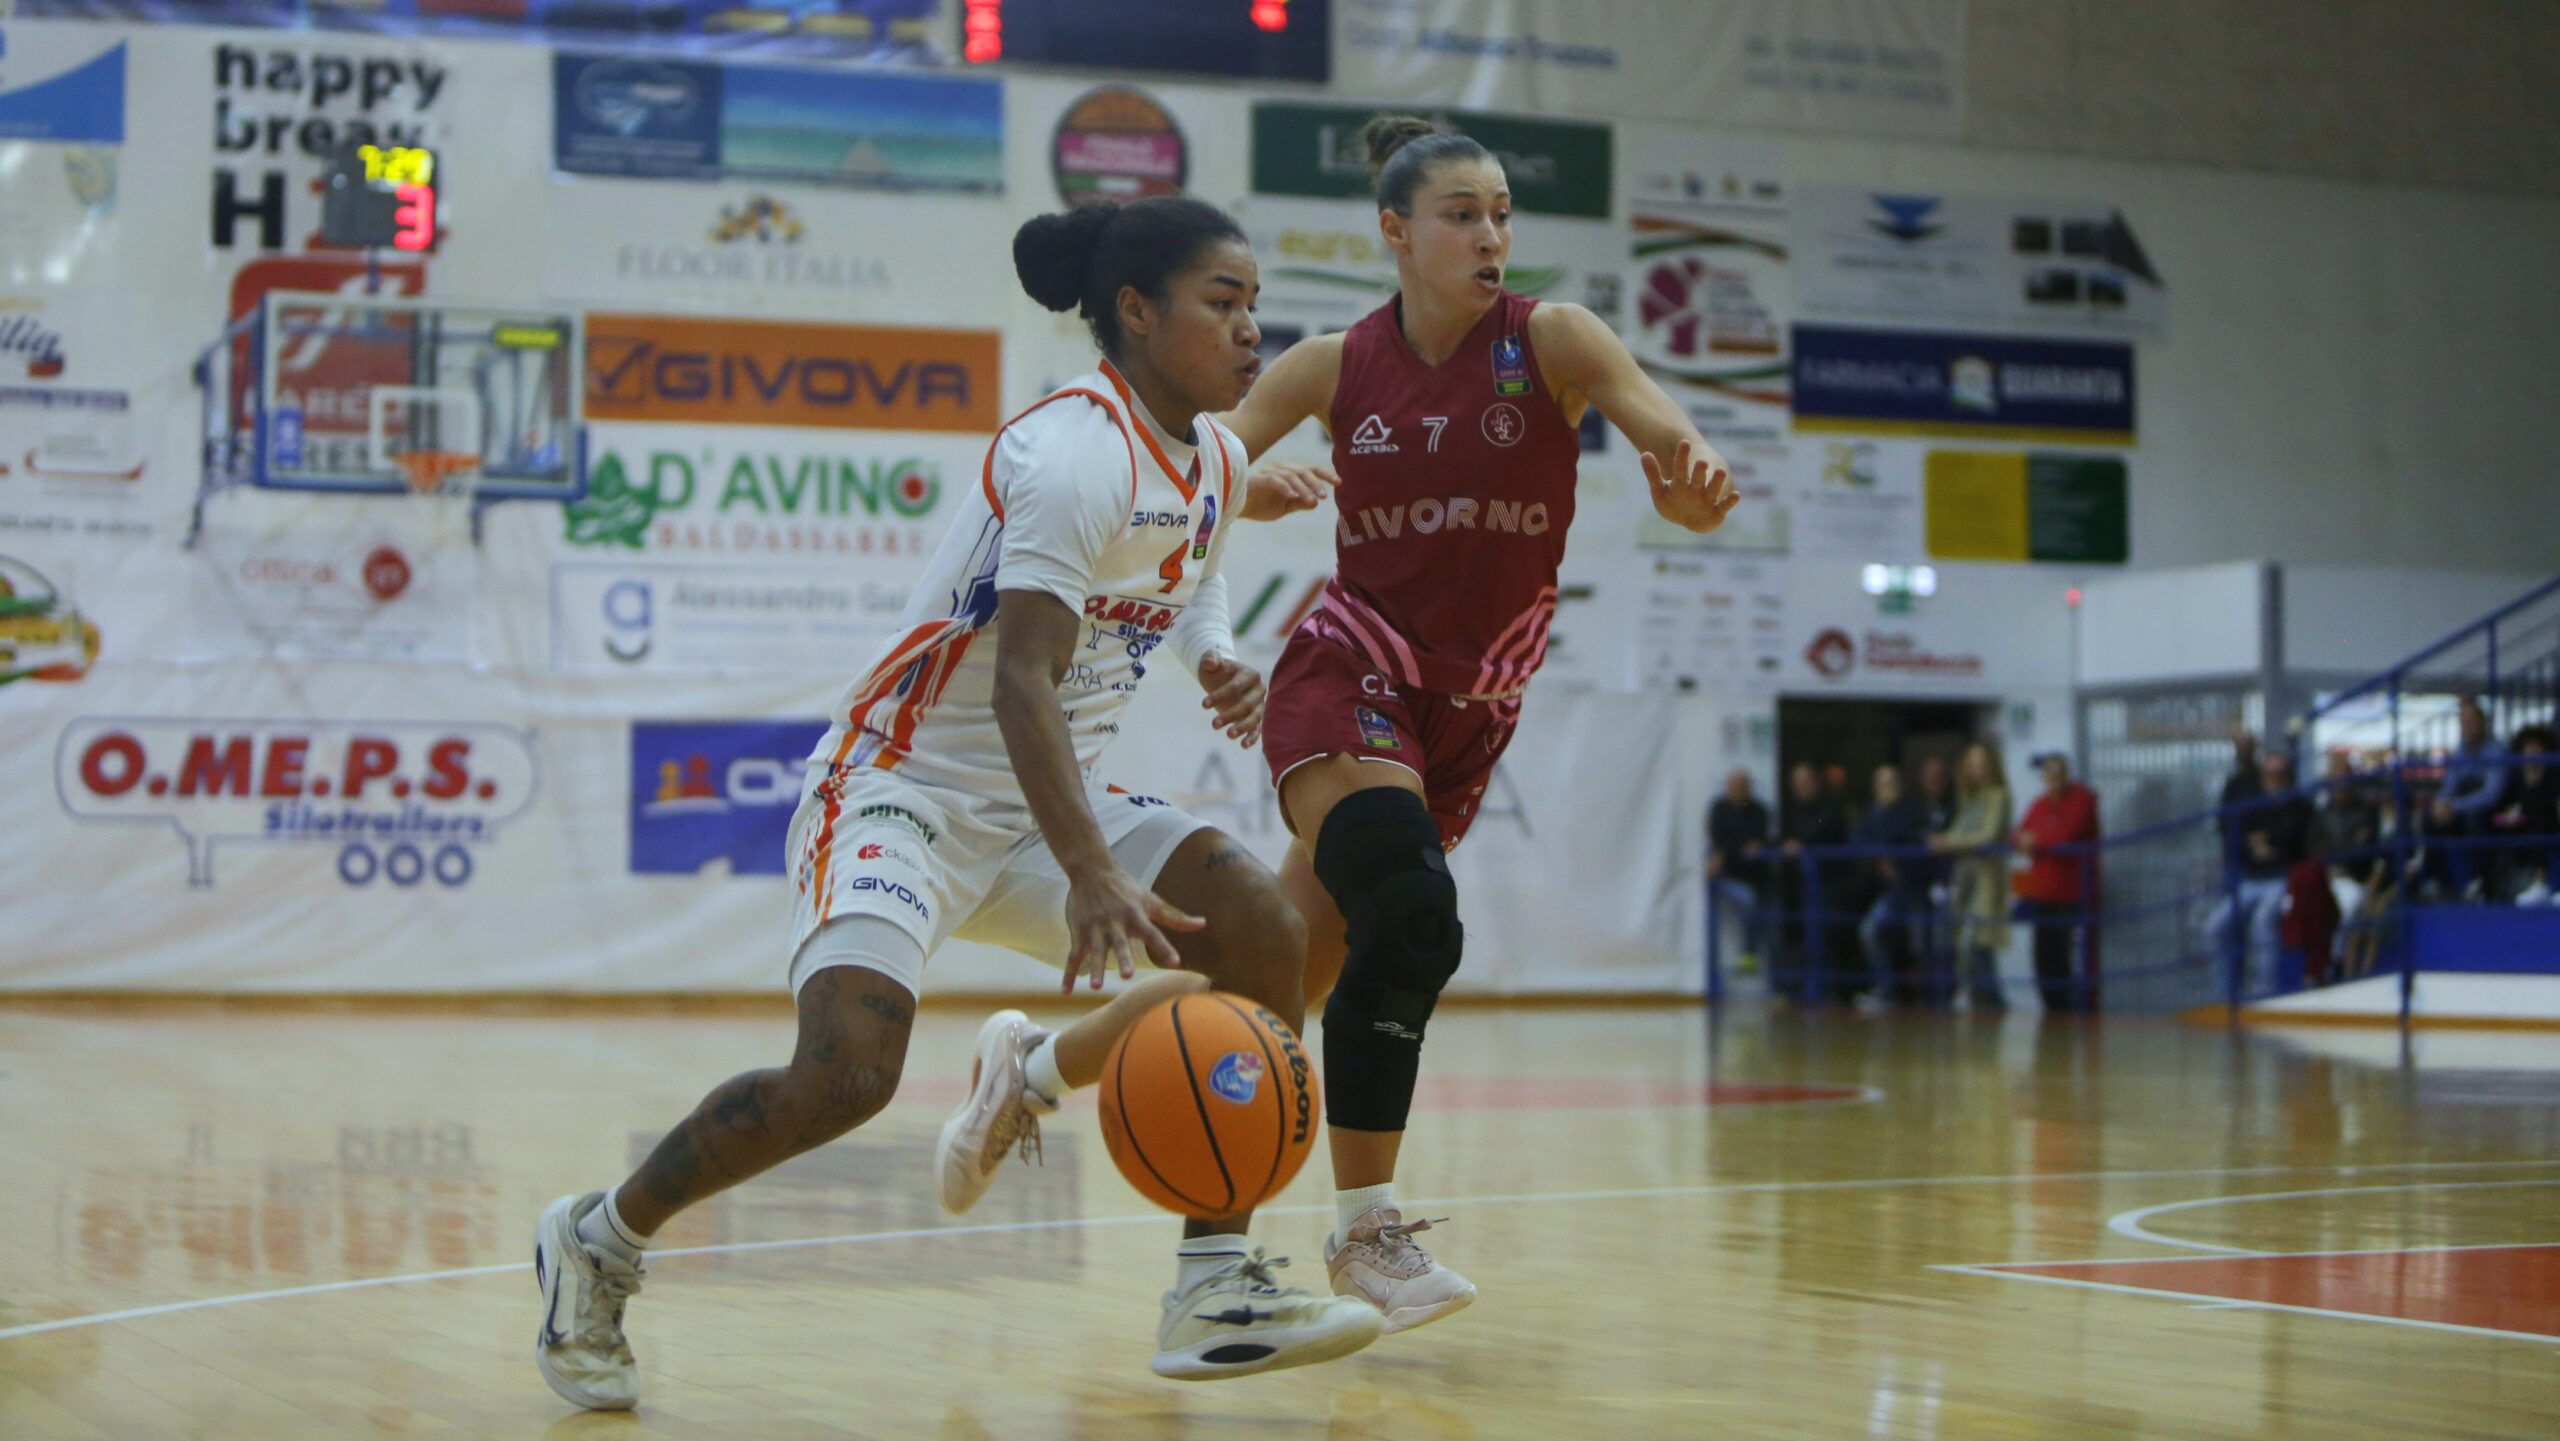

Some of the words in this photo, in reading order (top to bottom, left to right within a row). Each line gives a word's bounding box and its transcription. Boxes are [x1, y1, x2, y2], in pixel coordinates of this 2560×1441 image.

[212, 43, 445, 108] happy
[393, 182, 434, 251] 3
[616, 245, 752, 281] FLOOR
[764, 252, 891, 288] ITALIA
[653, 351, 969, 407] GIVOVA
[1421, 416, 1449, 453] 7
[1337, 497, 1550, 547] LIVORNO
[1158, 538, 1190, 594] 4
[80, 732, 496, 799] O.ME.P.S.
[263, 804, 486, 836] Silotrailers
[852, 877, 929, 925] GIVOVA
